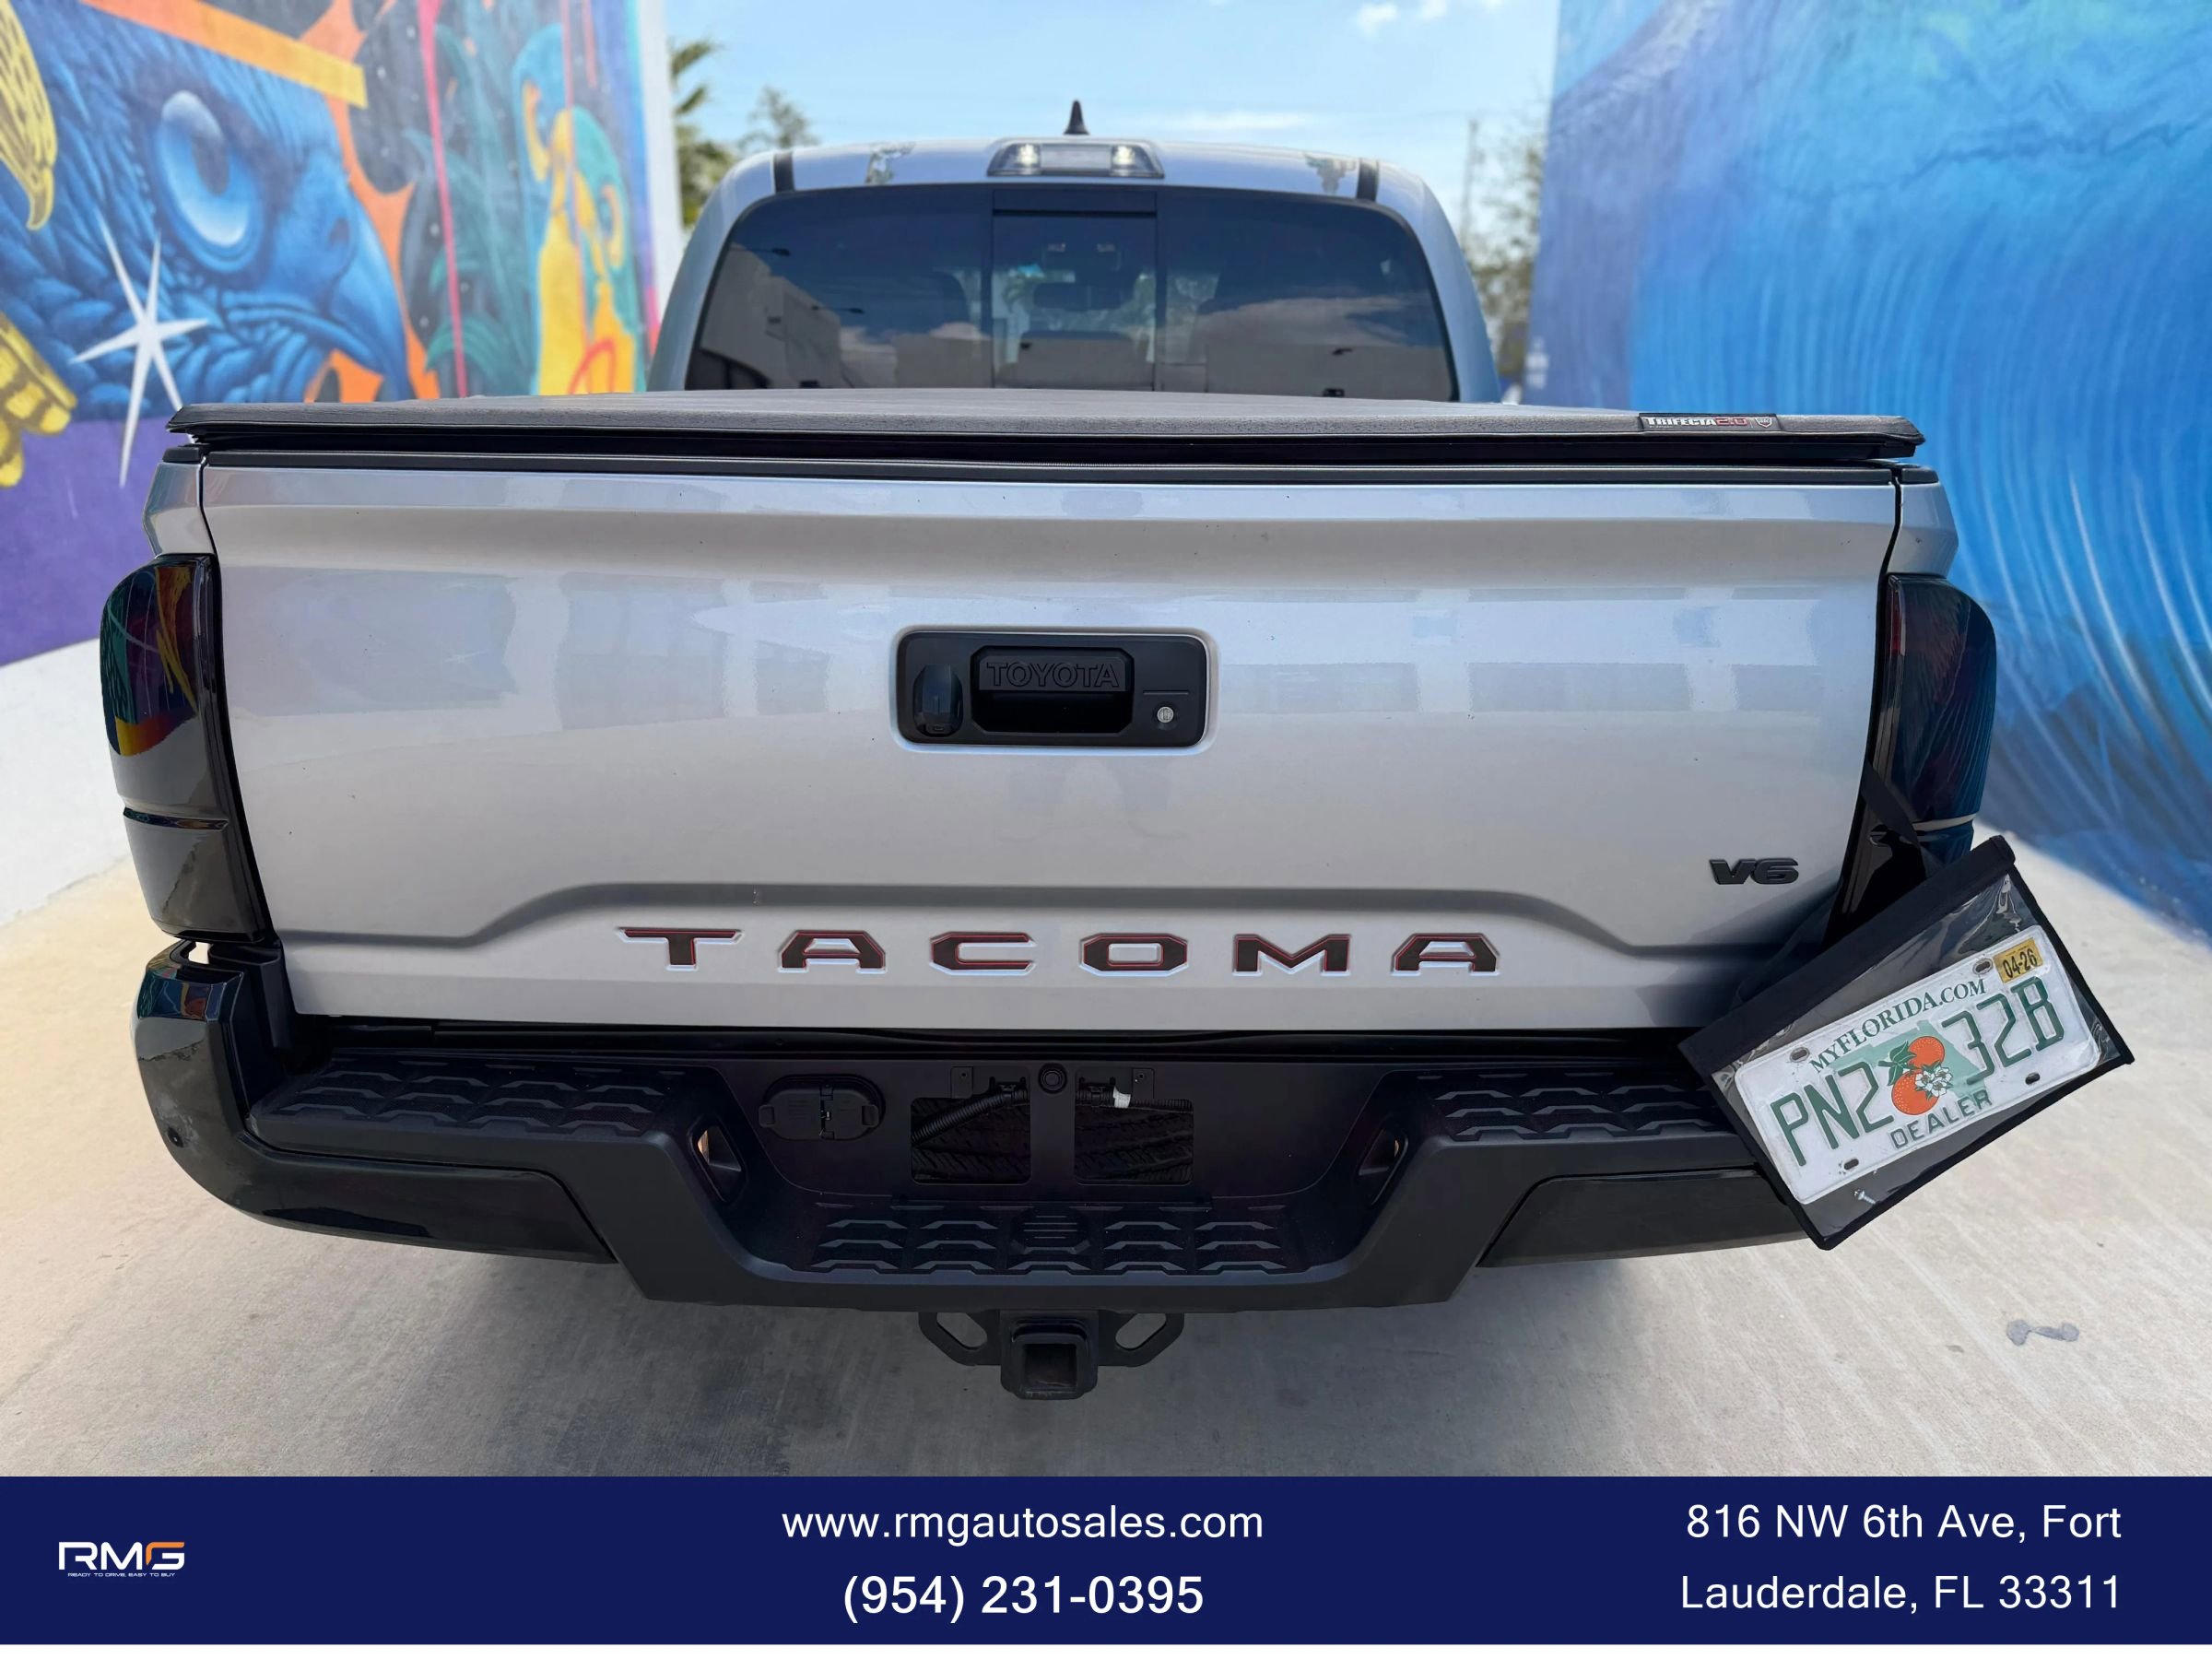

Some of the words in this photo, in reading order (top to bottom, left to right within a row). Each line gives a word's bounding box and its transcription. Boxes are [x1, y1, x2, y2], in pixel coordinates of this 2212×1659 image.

[986, 662, 1120, 688] TOYOTA
[1709, 858, 1799, 886] V6
[617, 926, 1500, 976] TACOMA
[2002, 947, 2038, 979] 04-26
[1809, 978, 1987, 1074] MYFLORIDA.COM
[1889, 1088, 1993, 1149] DEALER
